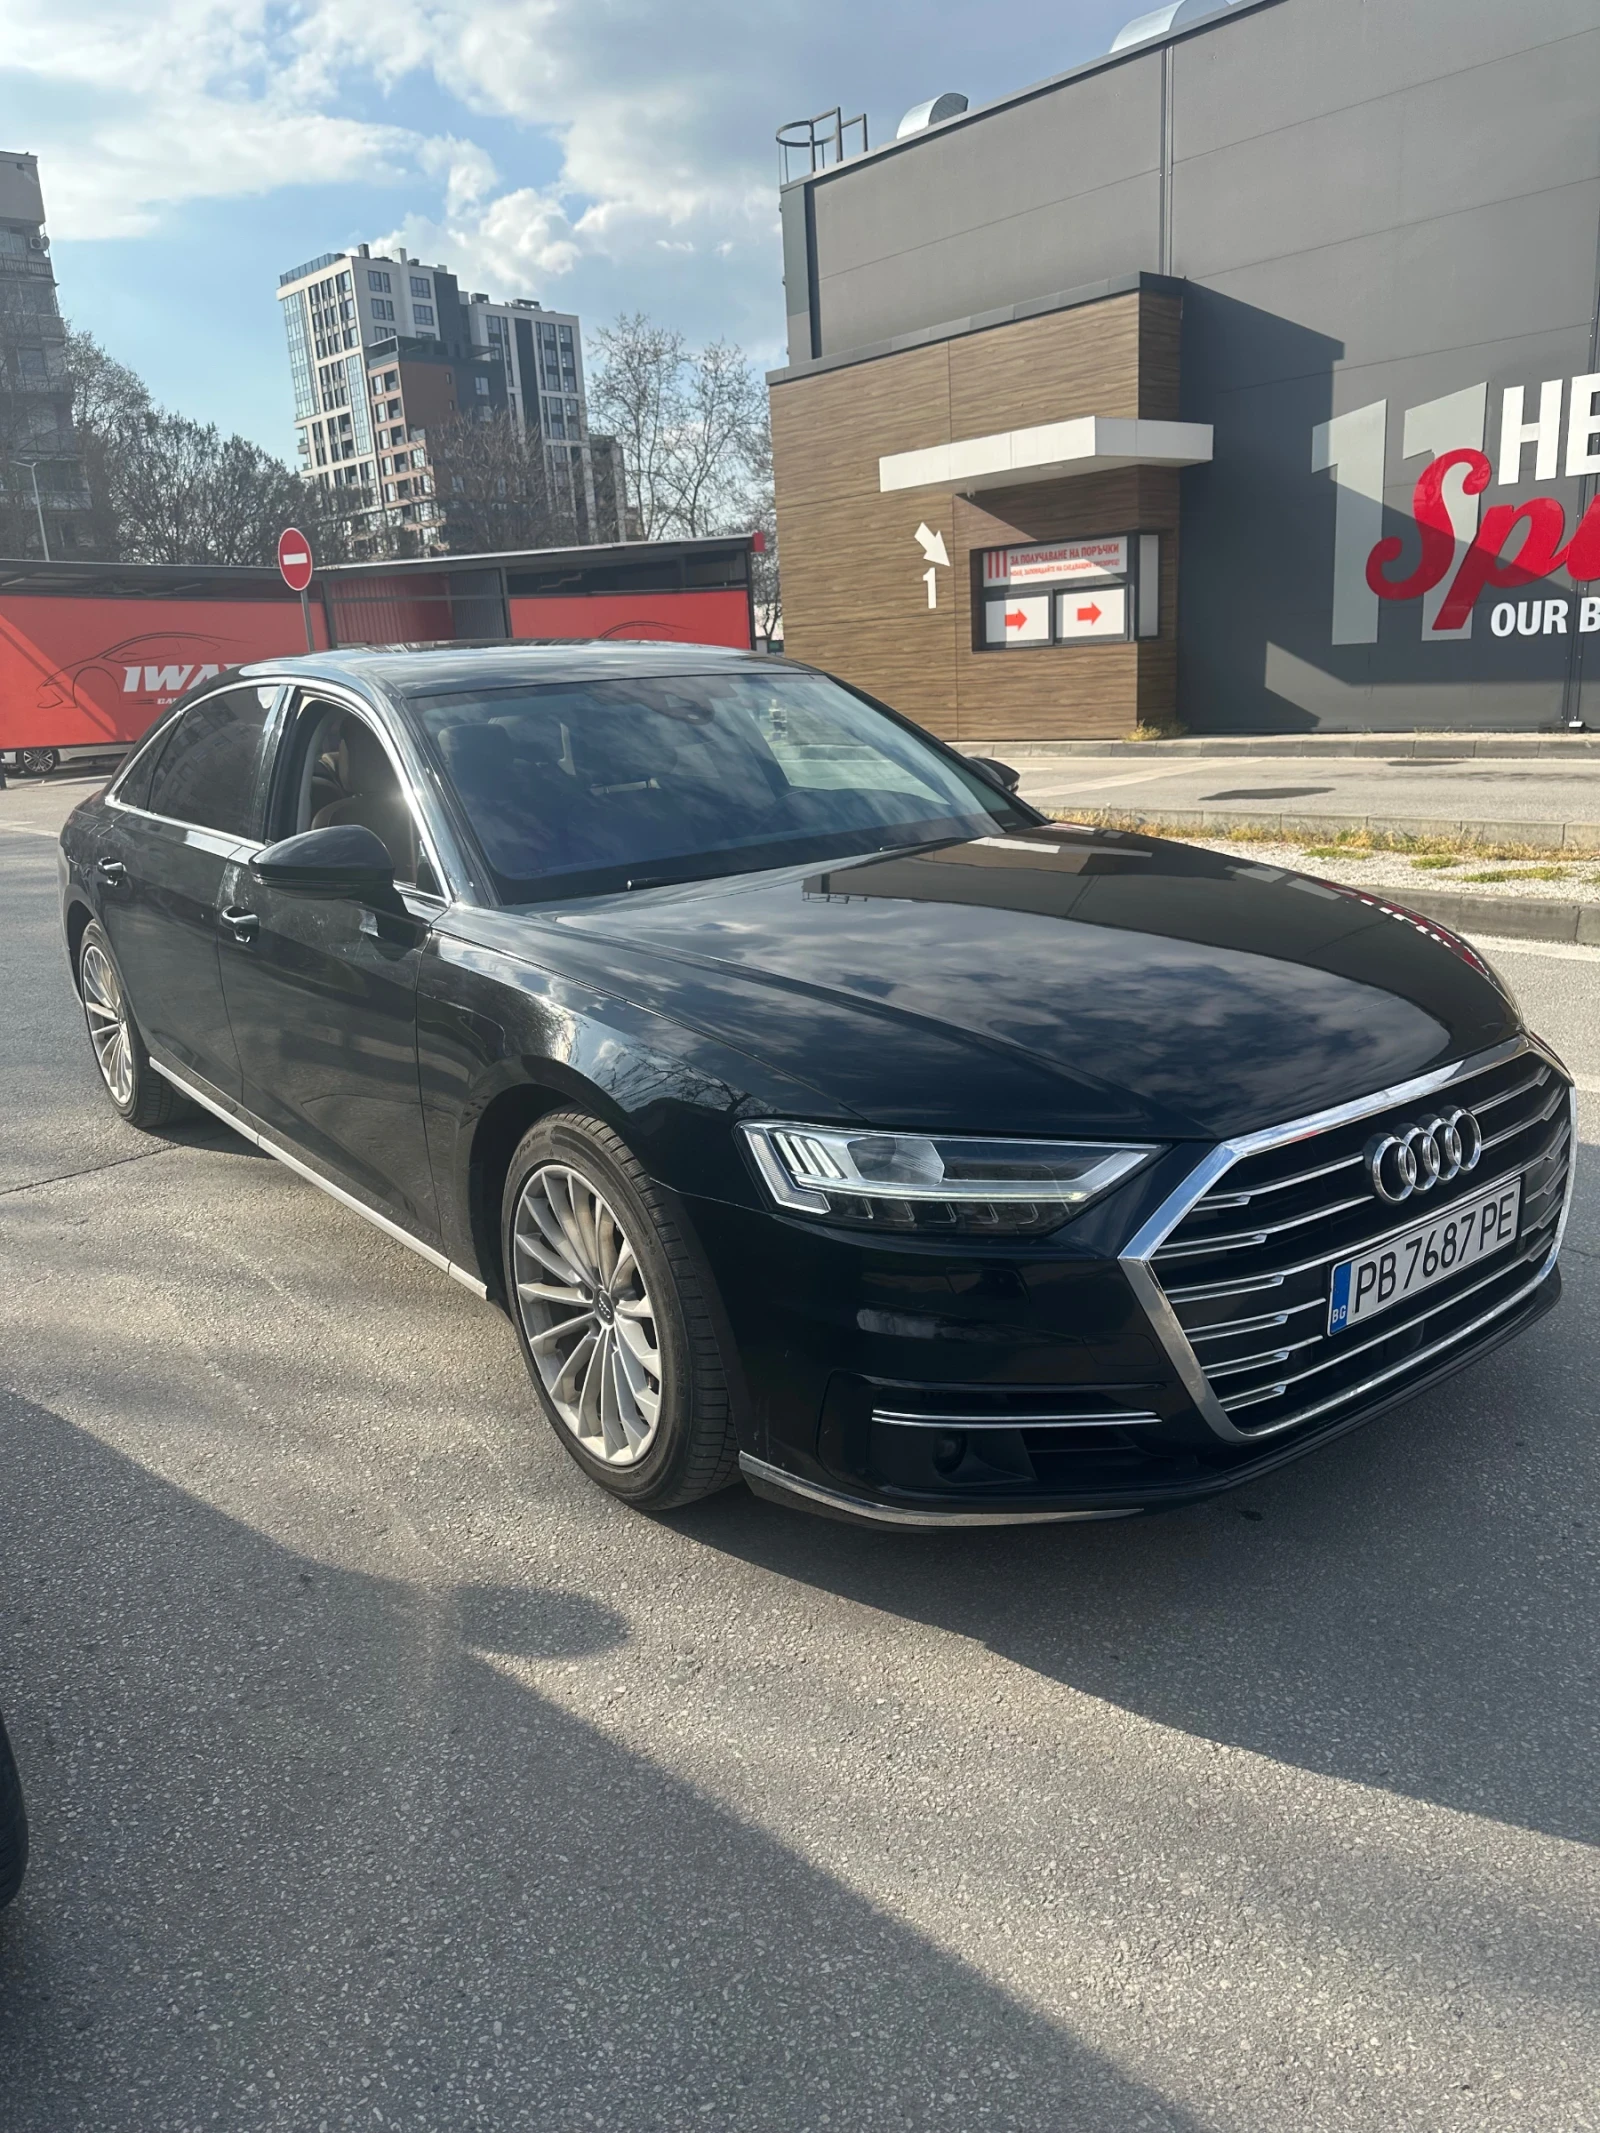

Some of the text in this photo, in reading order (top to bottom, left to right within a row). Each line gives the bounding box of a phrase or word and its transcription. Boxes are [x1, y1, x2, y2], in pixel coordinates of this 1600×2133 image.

[1010, 543, 1120, 566] ЗА ПОЛУЧАВАНЕ НА ПОРЪЧКИ
[922, 567, 937, 609] 1
[1490, 598, 1569, 637] OUR
[1354, 1190, 1516, 1314] PB 7687 PE
[1332, 1304, 1346, 1324] BG
